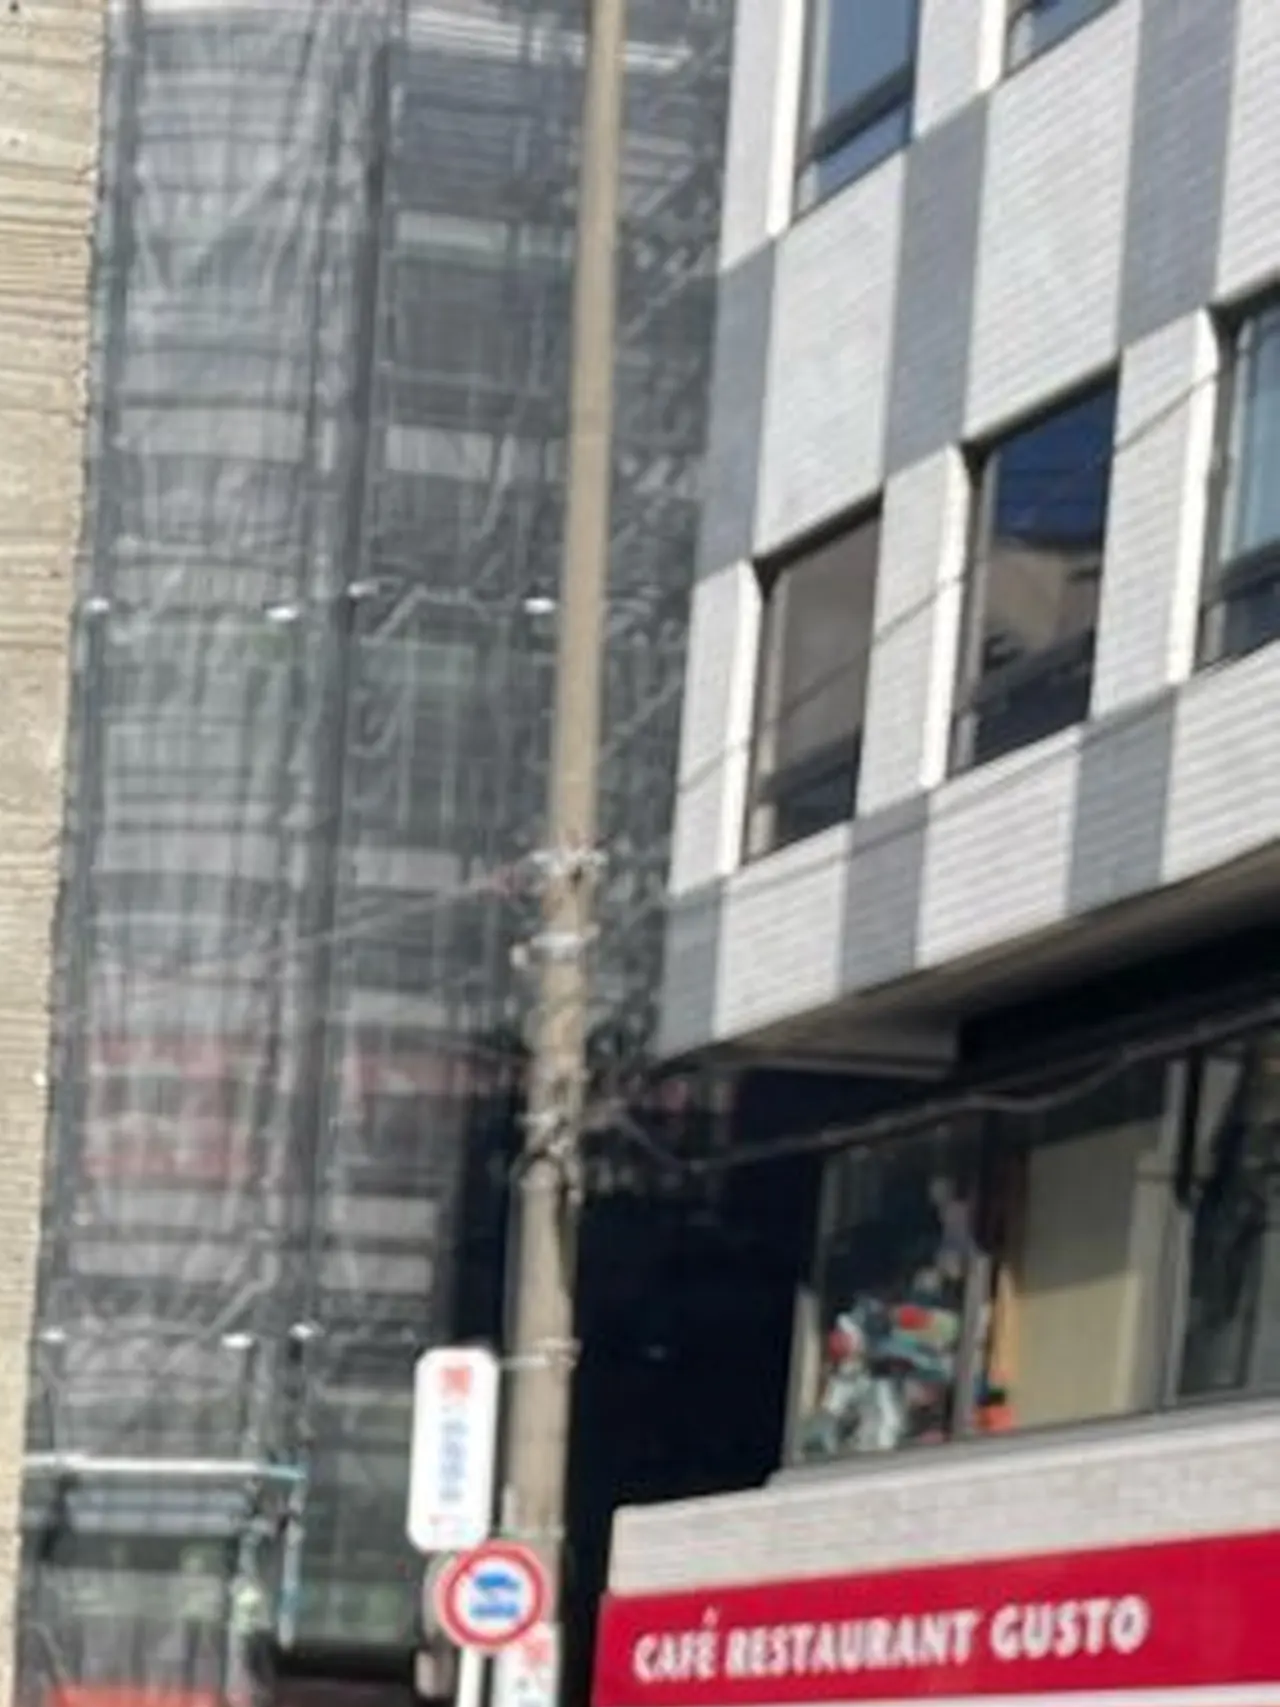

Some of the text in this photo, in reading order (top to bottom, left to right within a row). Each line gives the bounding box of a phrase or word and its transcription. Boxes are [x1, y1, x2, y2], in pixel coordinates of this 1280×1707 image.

[632, 1605, 719, 1683] CAFÉ
[725, 1610, 980, 1680] RESTAURANT
[989, 1595, 1149, 1660] GUSTO
